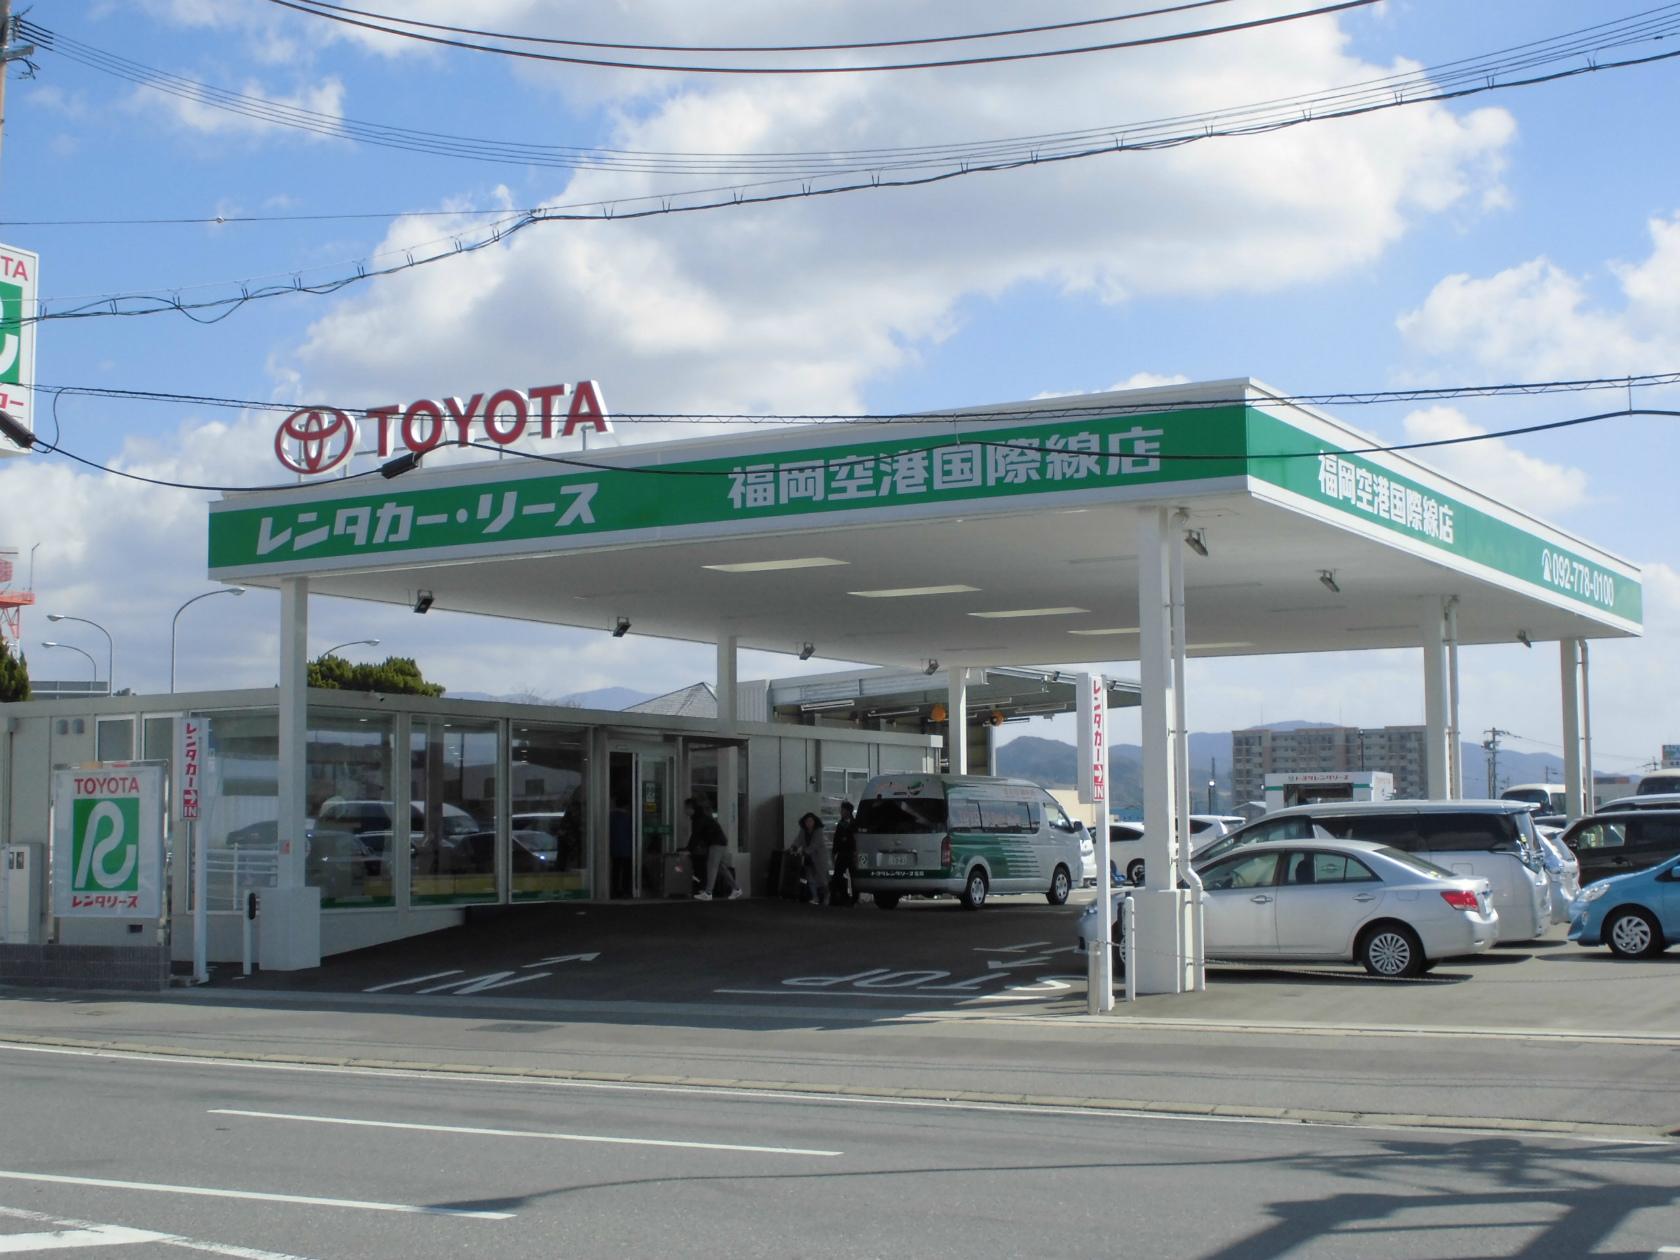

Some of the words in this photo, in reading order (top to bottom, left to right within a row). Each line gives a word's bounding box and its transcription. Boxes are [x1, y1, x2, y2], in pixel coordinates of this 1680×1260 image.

[366, 380, 612, 458] TOYOTA
[727, 426, 1164, 509] 福岡空港国際線店
[1318, 450, 1454, 544] 福岡空港国際線店
[256, 482, 600, 556] レンタカー・リース
[1553, 552, 1615, 607] 092-778-0100
[1093, 680, 1102, 762] レンタカー
[185, 722, 197, 788] レンタカー
[74, 776, 140, 795] TOYOTA
[184, 806, 197, 817] IN
[1094, 785, 1104, 799] IN
[72, 895, 138, 908] レンタリース
[362, 969, 553, 995] IN
